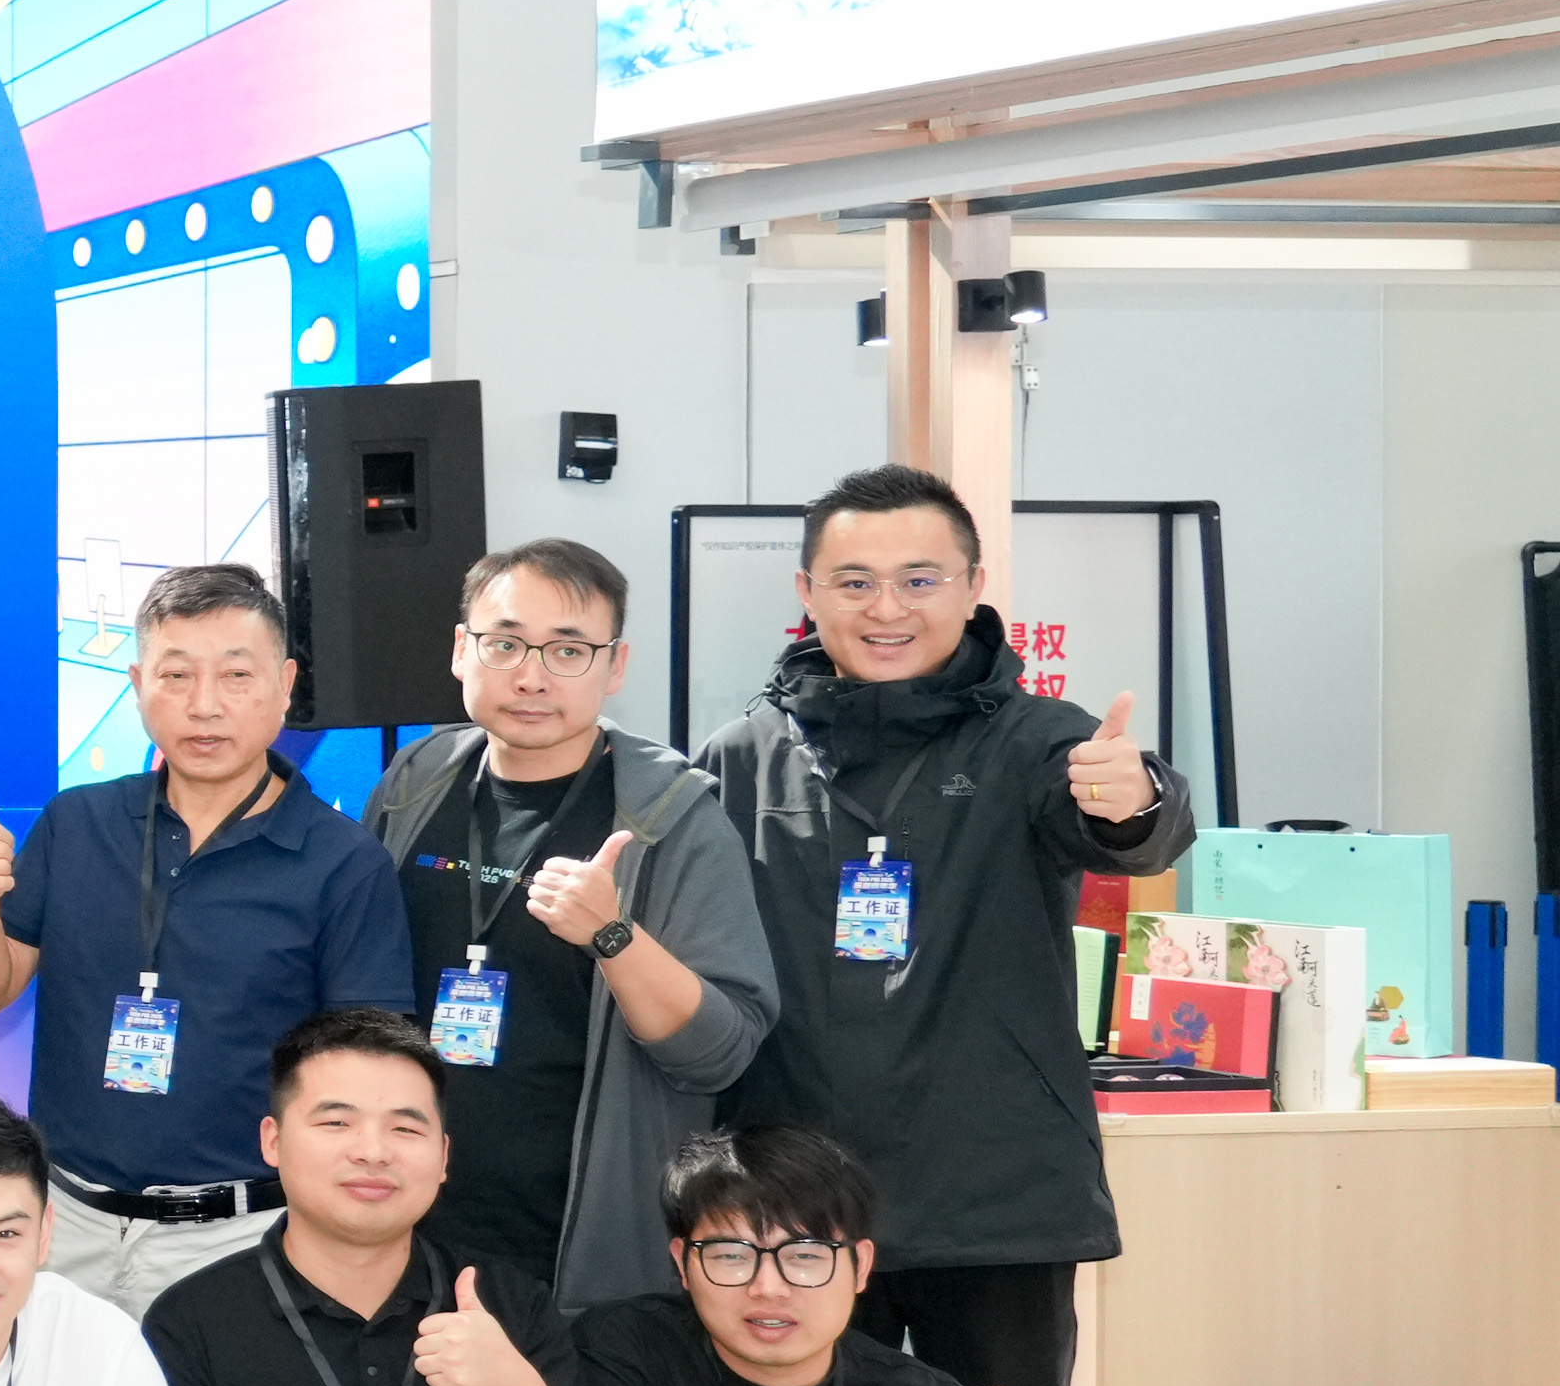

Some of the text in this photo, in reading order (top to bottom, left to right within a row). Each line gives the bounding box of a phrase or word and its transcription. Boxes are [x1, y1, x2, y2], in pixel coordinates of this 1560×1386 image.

[840, 897, 902, 920] 工作证
[440, 1004, 500, 1027] 工作证
[113, 1031, 169, 1054] 工作证
